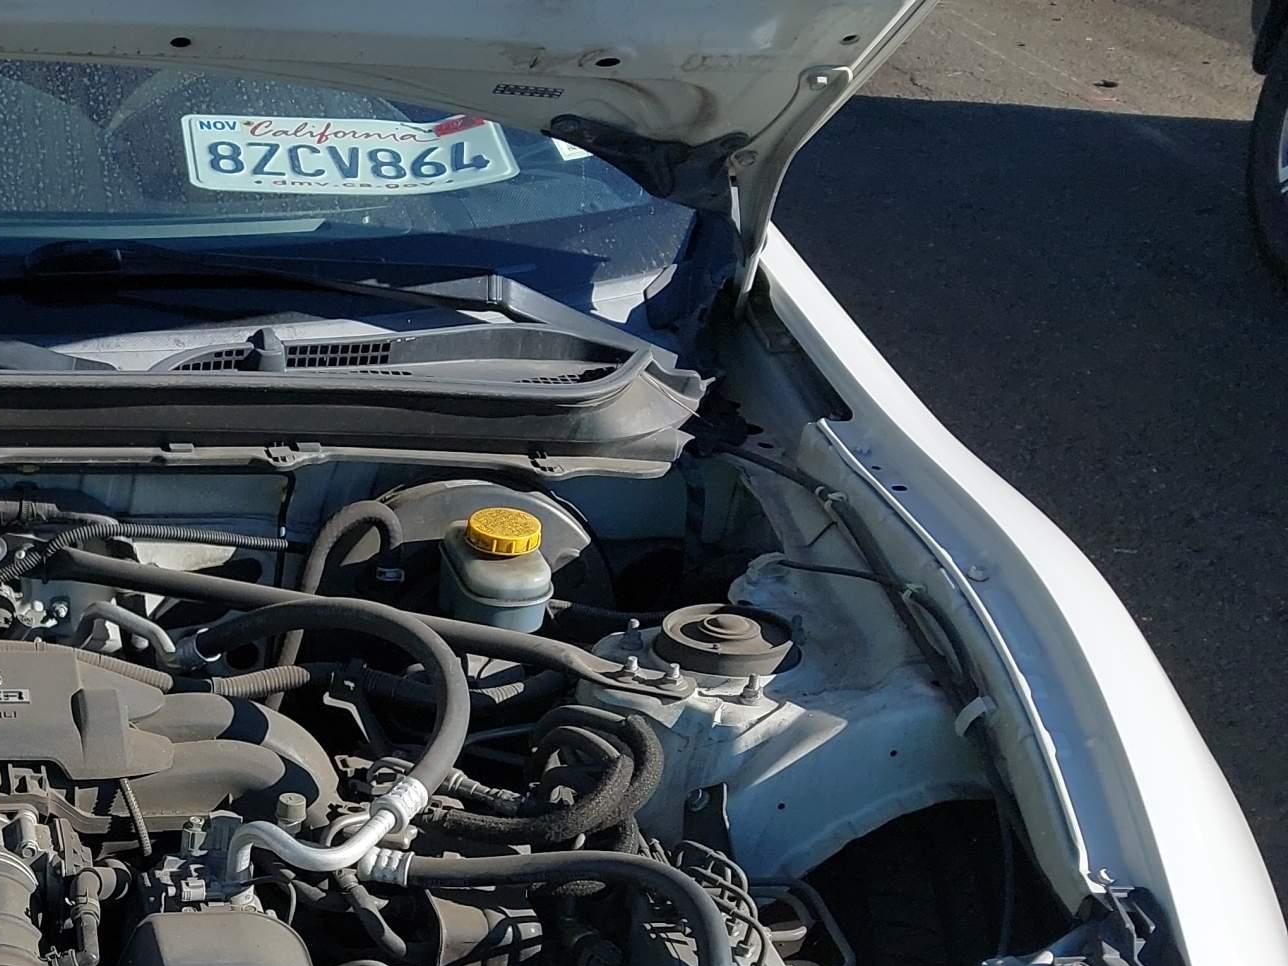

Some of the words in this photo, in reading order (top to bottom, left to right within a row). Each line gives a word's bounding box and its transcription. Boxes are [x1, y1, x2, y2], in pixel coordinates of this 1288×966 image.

[199, 119, 237, 131] NOV
[249, 120, 440, 145] California
[209, 141, 490, 181] 8ZCV864
[272, 178, 435, 190] dmv.ca.gov
